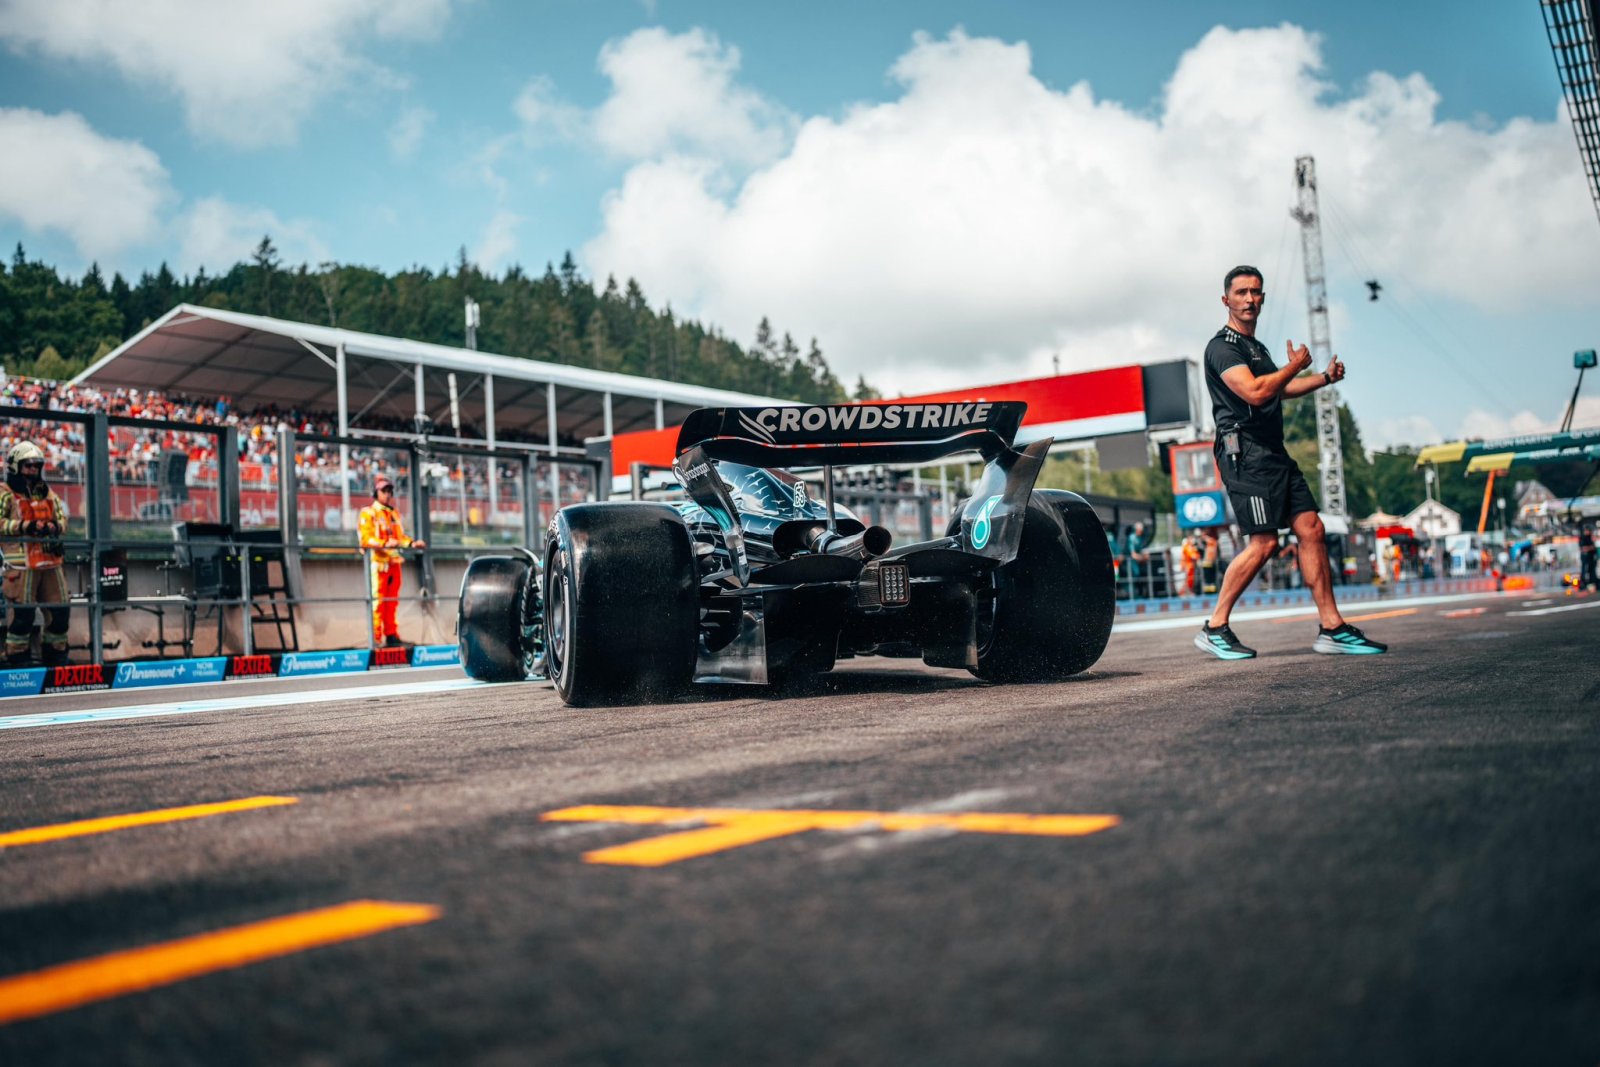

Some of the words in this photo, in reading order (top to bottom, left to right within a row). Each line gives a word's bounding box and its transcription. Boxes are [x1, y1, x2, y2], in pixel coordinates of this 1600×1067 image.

[756, 403, 993, 432] CROWDSTRIKE
[54, 664, 104, 686] DEXTER
[117, 662, 186, 683] Paramount+
[233, 655, 272, 675] DEXTER
[2, 681, 37, 689] STREAMING
[8, 672, 30, 681] NOW
